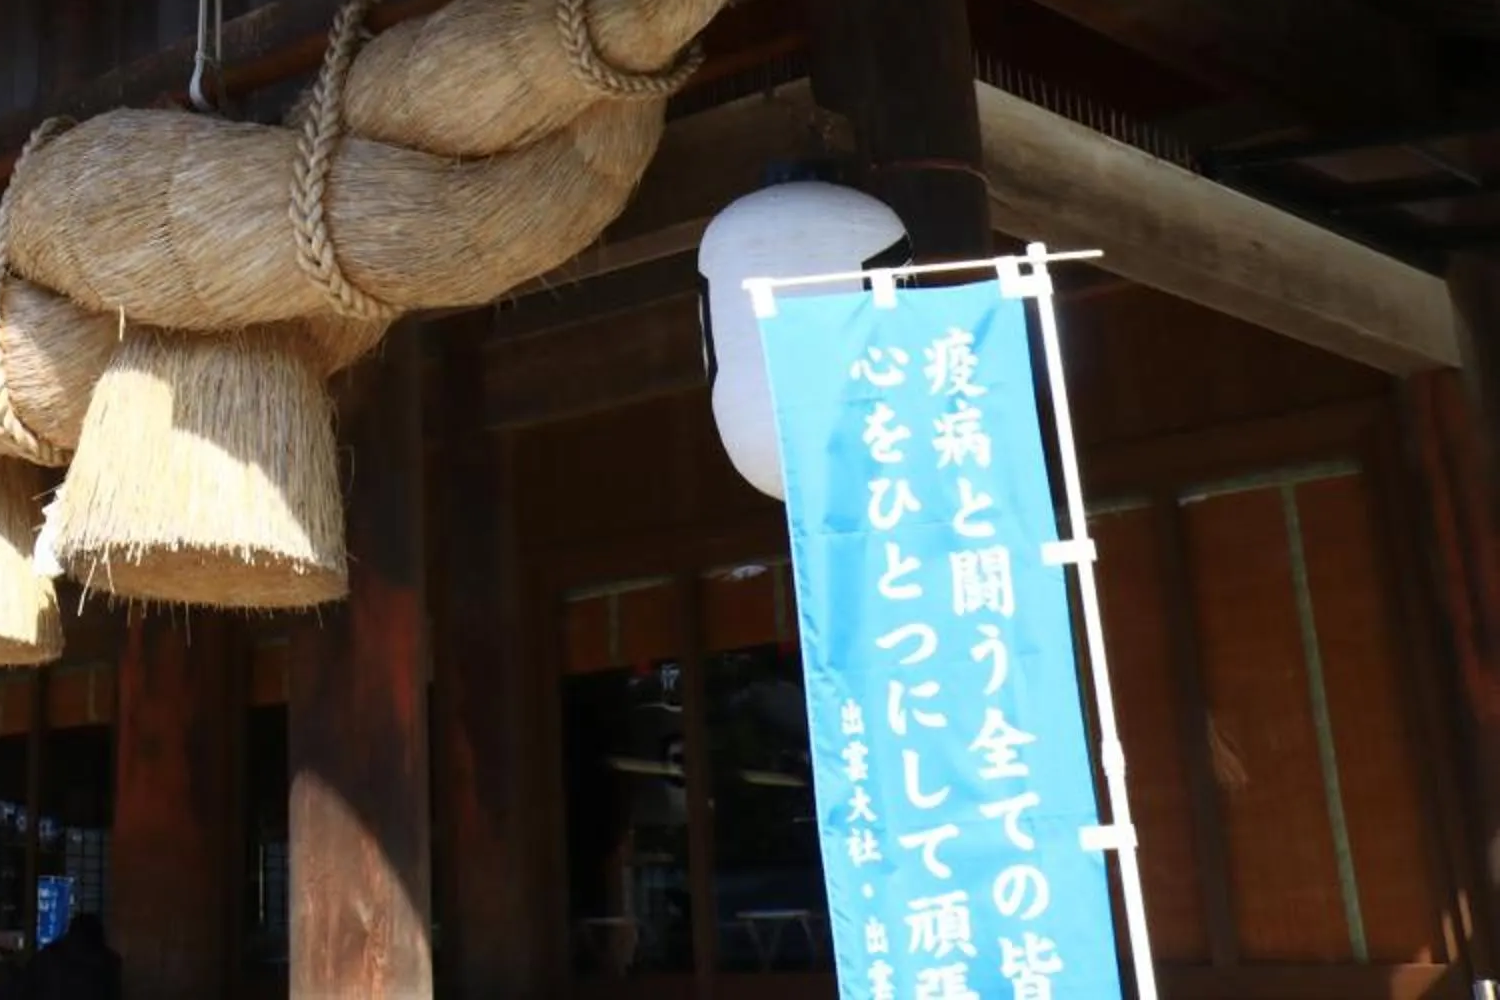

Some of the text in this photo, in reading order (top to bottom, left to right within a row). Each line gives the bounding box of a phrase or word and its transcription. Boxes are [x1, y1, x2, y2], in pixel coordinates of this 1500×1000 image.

[922, 326, 1064, 1000] 疫病と闘う全ての皆
